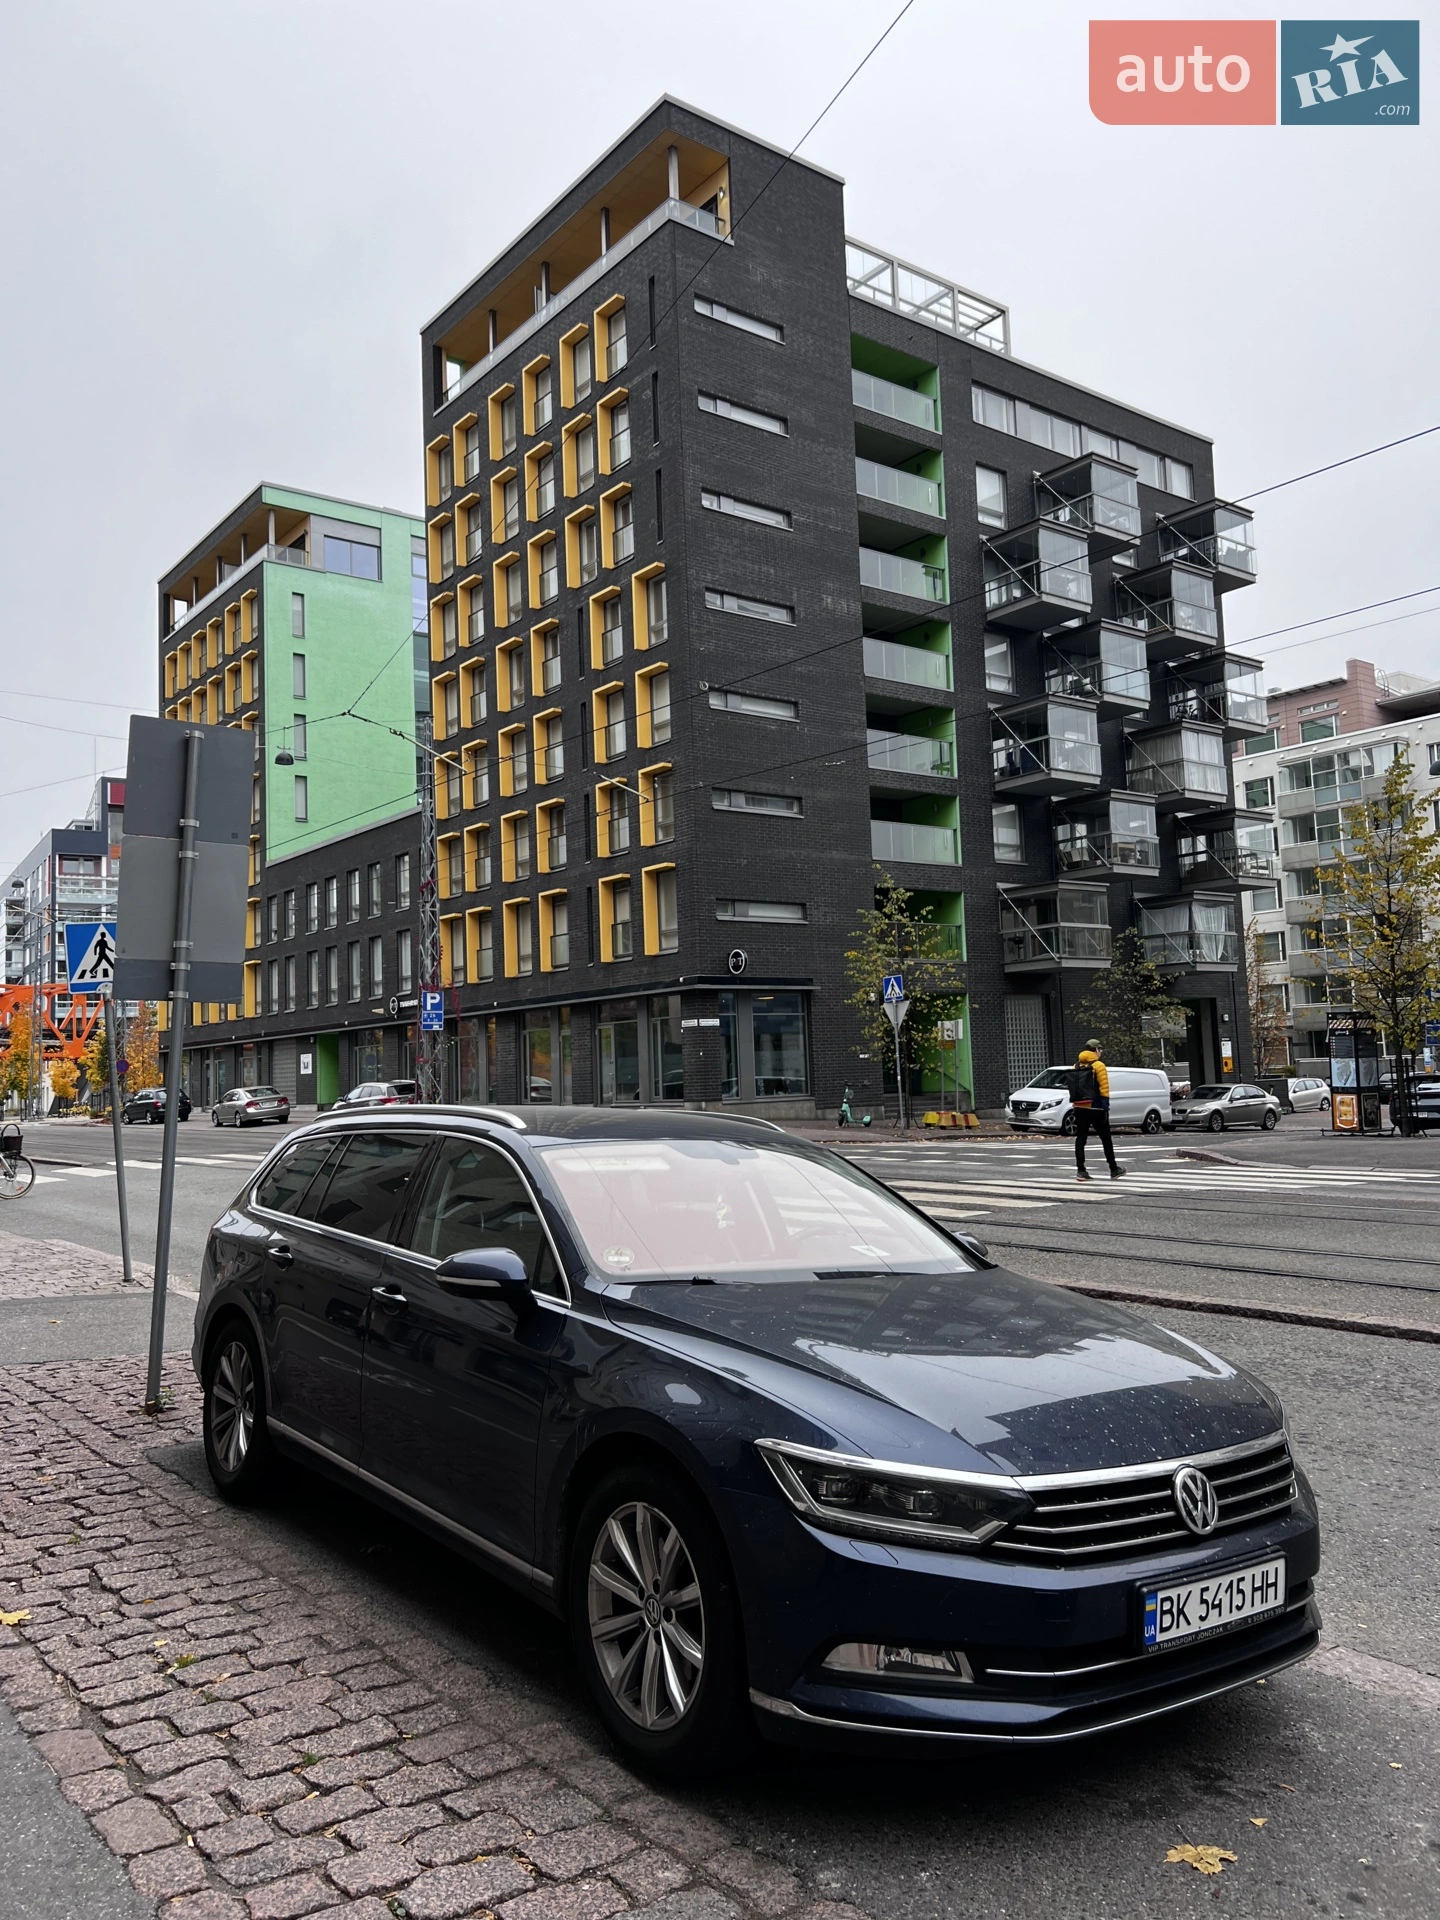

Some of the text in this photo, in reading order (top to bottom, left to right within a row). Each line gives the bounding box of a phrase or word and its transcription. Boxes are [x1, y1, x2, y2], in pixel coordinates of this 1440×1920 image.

[426, 992, 440, 1011] P
[1159, 1566, 1279, 1634] BK 5415 HH
[1144, 1625, 1156, 1638] UA
[1148, 1642, 1159, 1654] VIP
[1160, 1633, 1196, 1649] TRANSPORT
